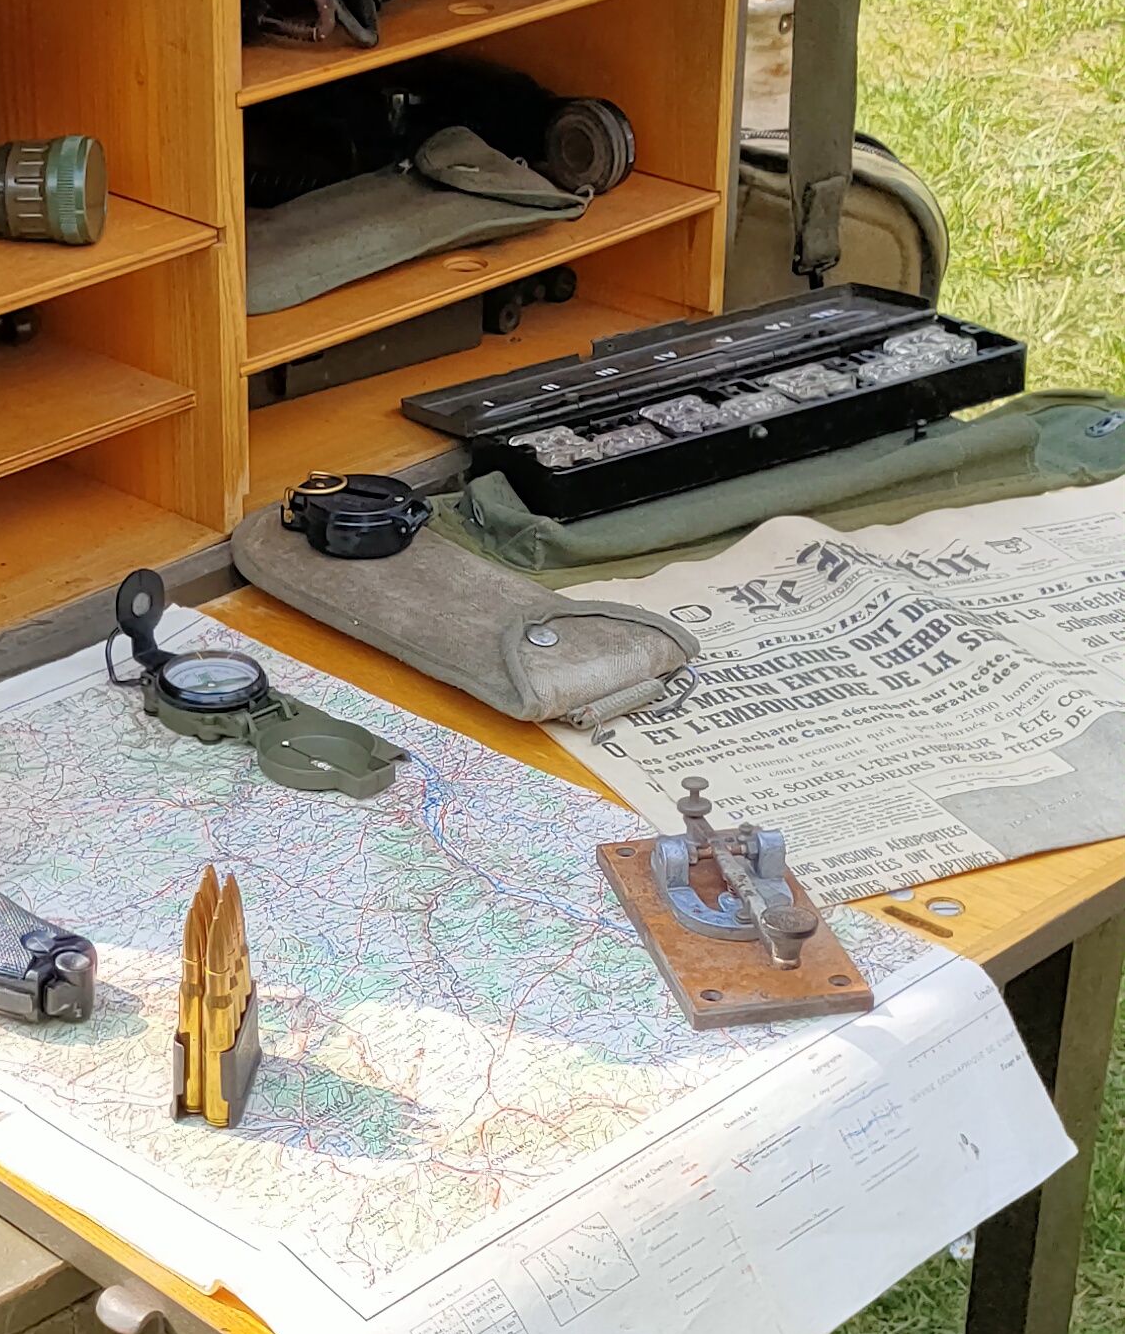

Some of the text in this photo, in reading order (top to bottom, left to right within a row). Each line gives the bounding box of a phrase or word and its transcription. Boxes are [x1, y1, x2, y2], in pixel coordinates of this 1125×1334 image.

[757, 588, 892, 651] REDEVIENT
[958, 593, 1024, 607] HAMP
[848, 618, 903, 653] ONT
[641, 650, 961, 746] ET L'EMBOUCHURE DE LA
[666, 738, 738, 761] combats
[741, 717, 815, 743] acharnés
[819, 714, 838, 726] se
[921, 687, 949, 704] sur
[949, 676, 968, 691] la
[971, 651, 1012, 682] côte,
[668, 756, 705, 773] plus
[707, 740, 775, 764] proches
[778, 733, 798, 746] de
[801, 722, 851, 740] Caen,
[931, 684, 990, 714] gravité
[992, 661, 1021, 685] des
[688, 681, 780, 710] MATIN
[778, 663, 867, 691] ENTRE
[714, 793, 747, 810] FIN
[751, 786, 780, 801] DE
[783, 768, 857, 794] SOIRÉE,
[1018, 708, 1057, 735] ÉTÉ
[727, 788, 836, 821] D'ÉVACUER
[837, 760, 937, 793] PLUSIEURS
[938, 752, 967, 766] DE
[969, 750, 1002, 763] SES
[1064, 705, 1093, 730] DE
[816, 840, 965, 888] PARACHUTÉES ONT ÉTÉ
[822, 824, 968, 870] DIVISIONS AÉROPORTÉES
[893, 869, 926, 888] SOIT
[929, 851, 999, 879] CAPTURÉES
